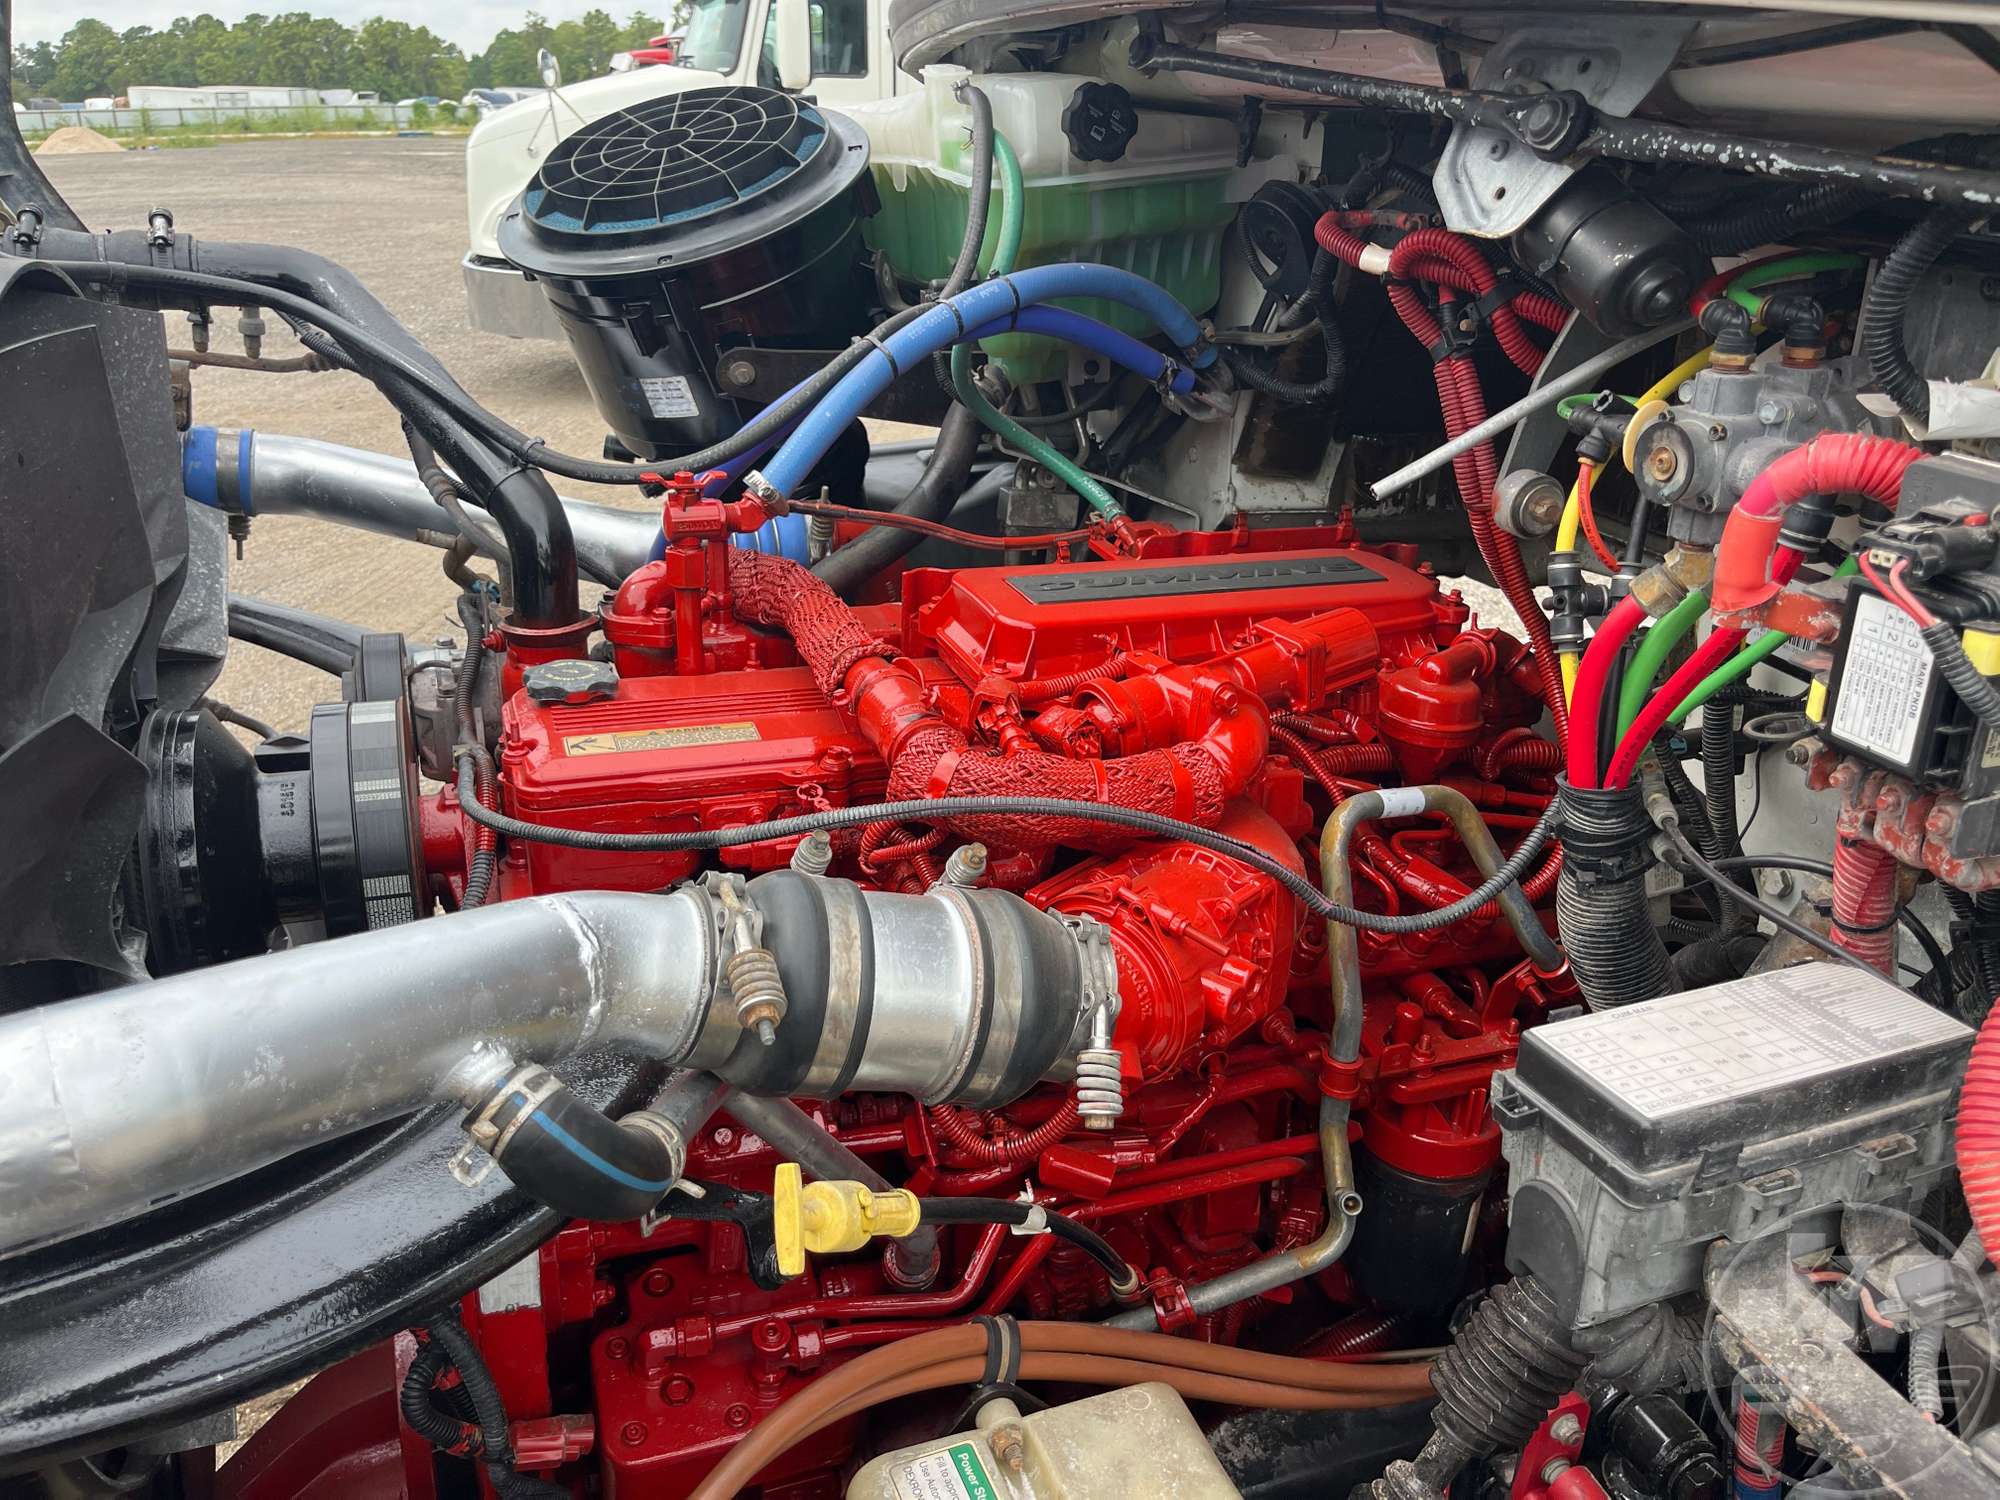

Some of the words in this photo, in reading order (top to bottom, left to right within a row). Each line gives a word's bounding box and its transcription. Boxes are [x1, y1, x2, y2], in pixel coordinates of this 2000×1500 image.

[1026, 560, 1365, 592] CUMMINS
[1886, 631, 1898, 642] 2
[1906, 638, 1918, 649] 3
[1915, 661, 1927, 688] MAIN
[1908, 689, 1921, 719] PNDB
[919, 1460, 930, 1478] Use
[935, 1456, 945, 1468] Fill
[957, 1452, 979, 1485] Power
